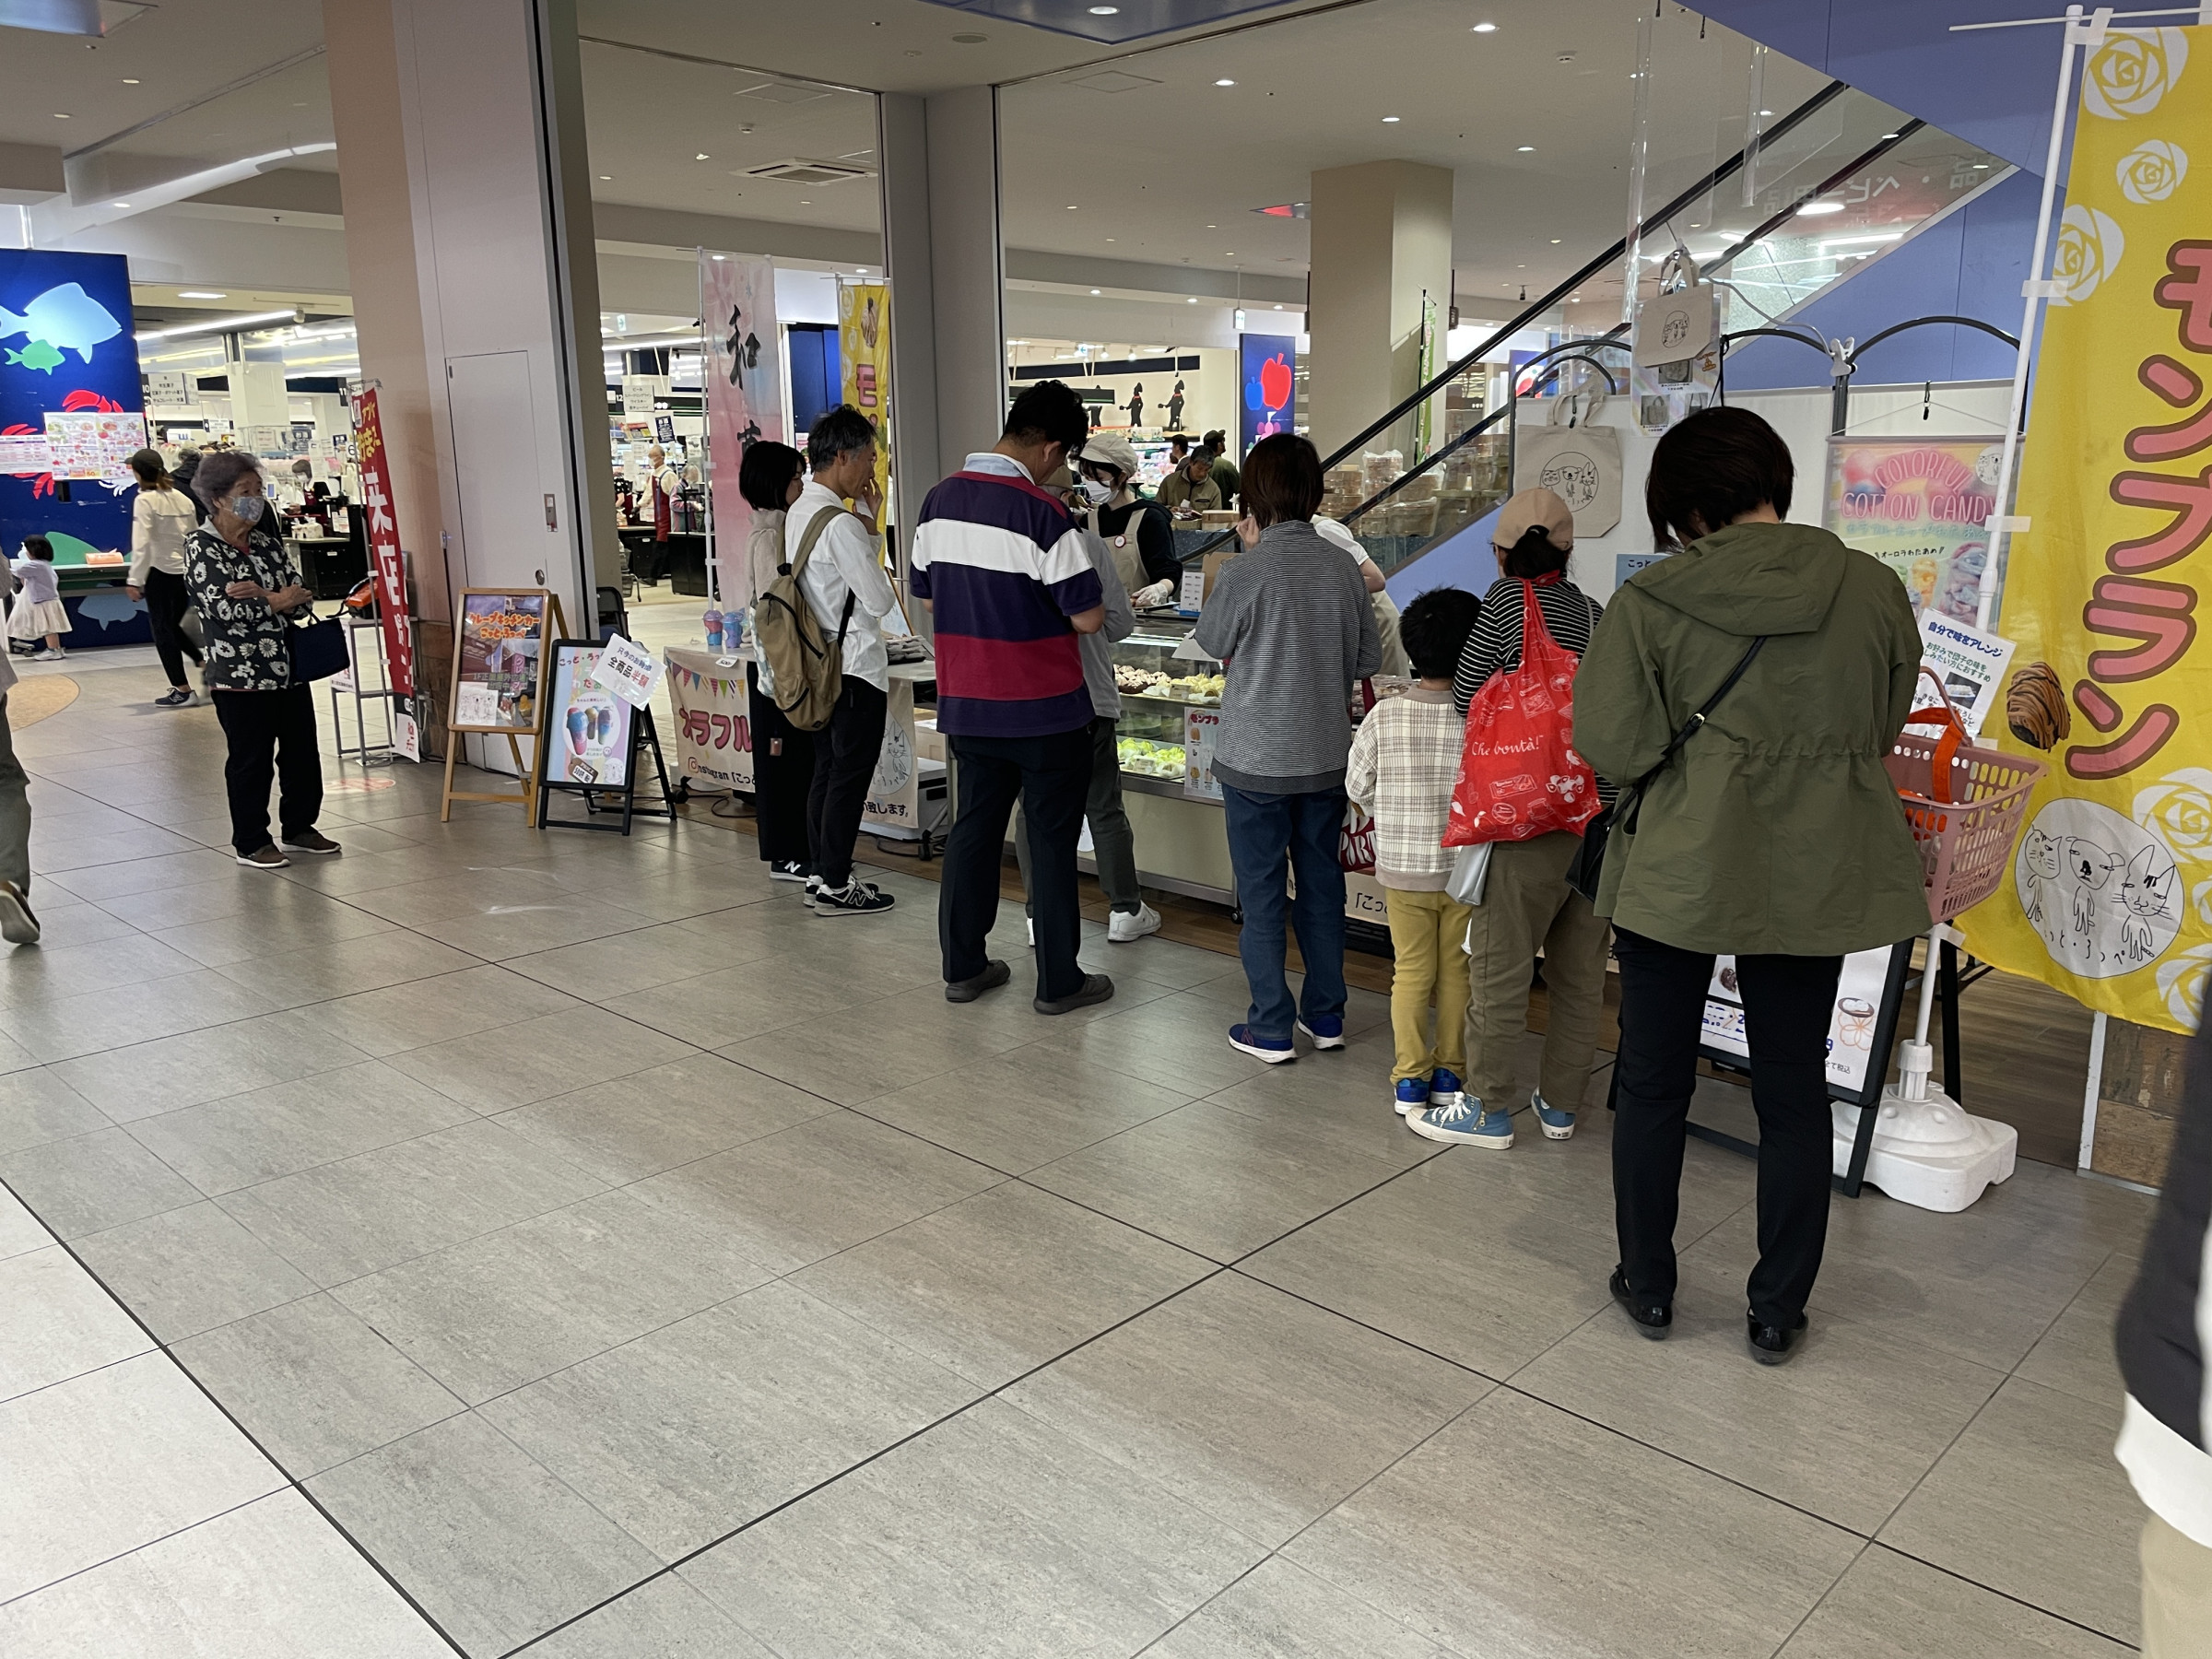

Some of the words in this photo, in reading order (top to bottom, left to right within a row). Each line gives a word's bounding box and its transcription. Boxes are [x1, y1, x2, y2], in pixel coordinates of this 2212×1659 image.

[1874, 450, 1973, 496] COLORFUL
[1843, 492, 1920, 521] COTTON
[1927, 621, 2003, 658] 自分で味をアレンジ
[1471, 741, 1491, 757] Che
